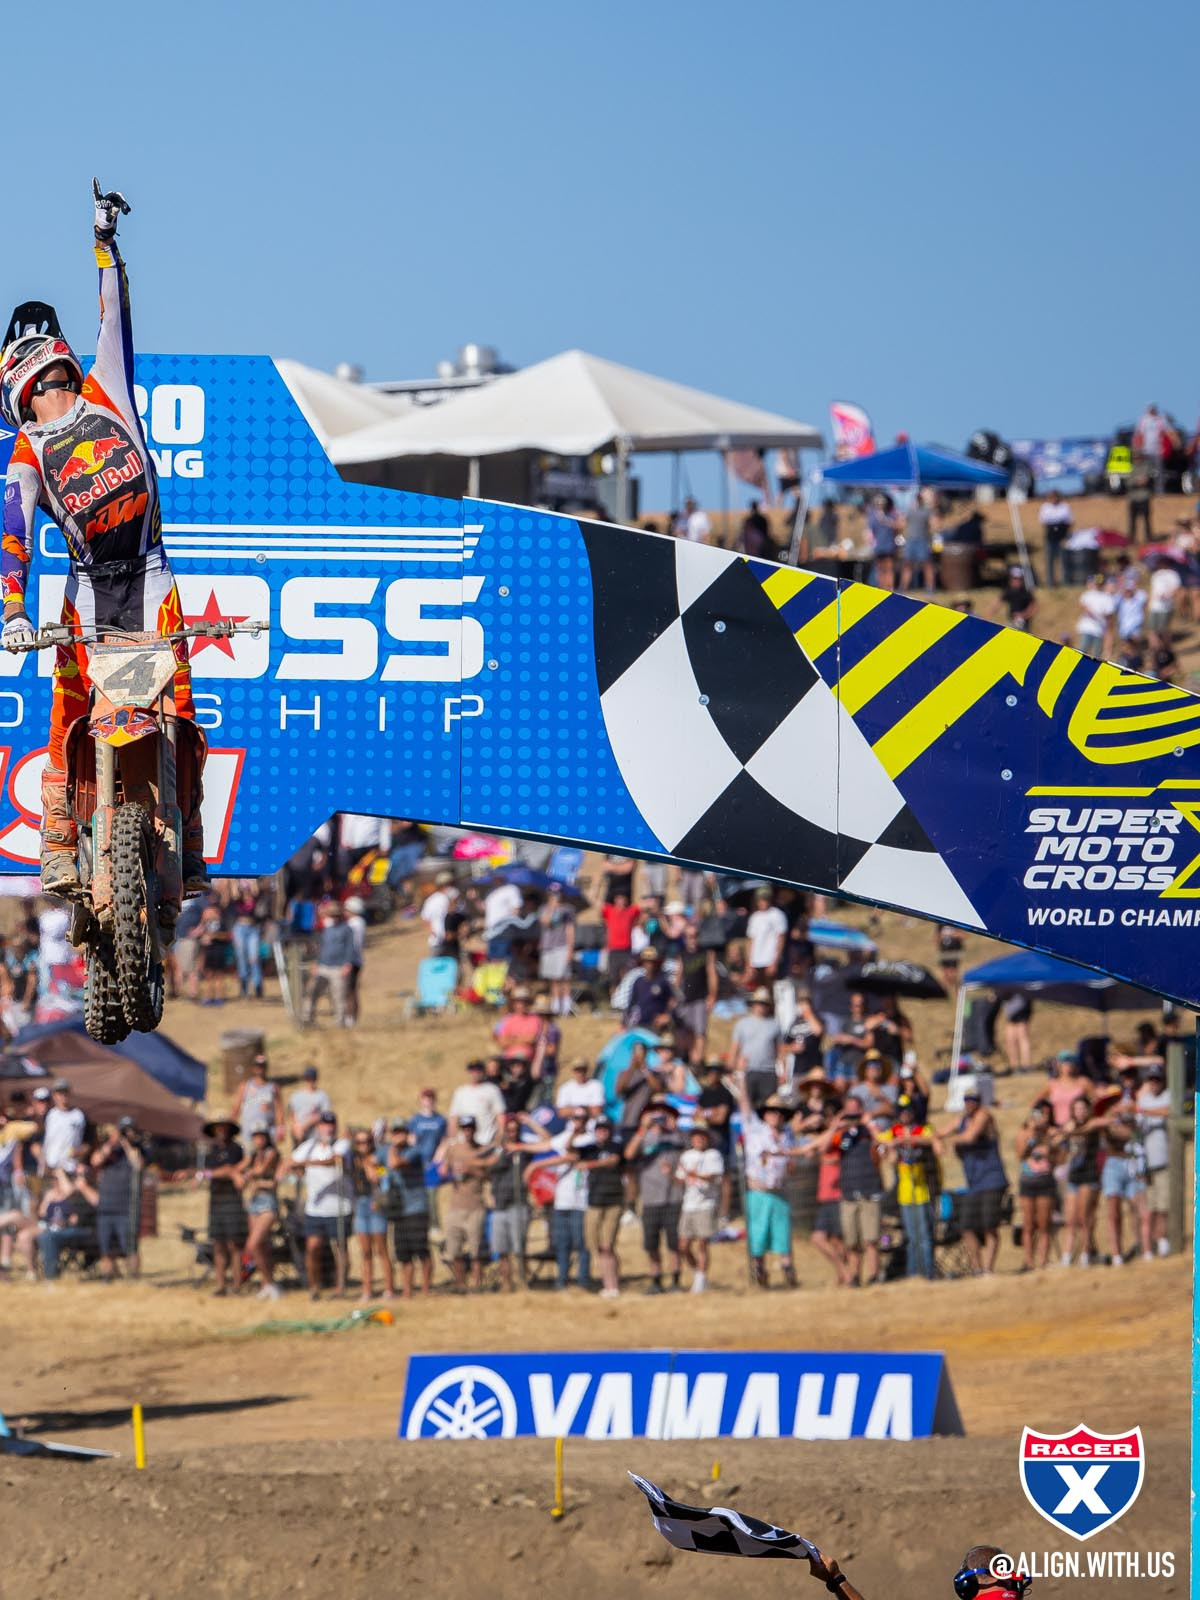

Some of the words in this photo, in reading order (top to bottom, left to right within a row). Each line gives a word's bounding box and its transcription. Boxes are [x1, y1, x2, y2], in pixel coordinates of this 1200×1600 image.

[62, 473, 108, 516] Red
[101, 450, 144, 491] Bull
[86, 491, 148, 542] KTM
[103, 652, 157, 697] 4
[1024, 808, 1184, 834] SUPER
[1034, 836, 1175, 863] MOTO
[1023, 865, 1177, 891] CROSS
[1027, 908, 1115, 926] WORLD
[528, 1372, 913, 1440] YAMAHA
